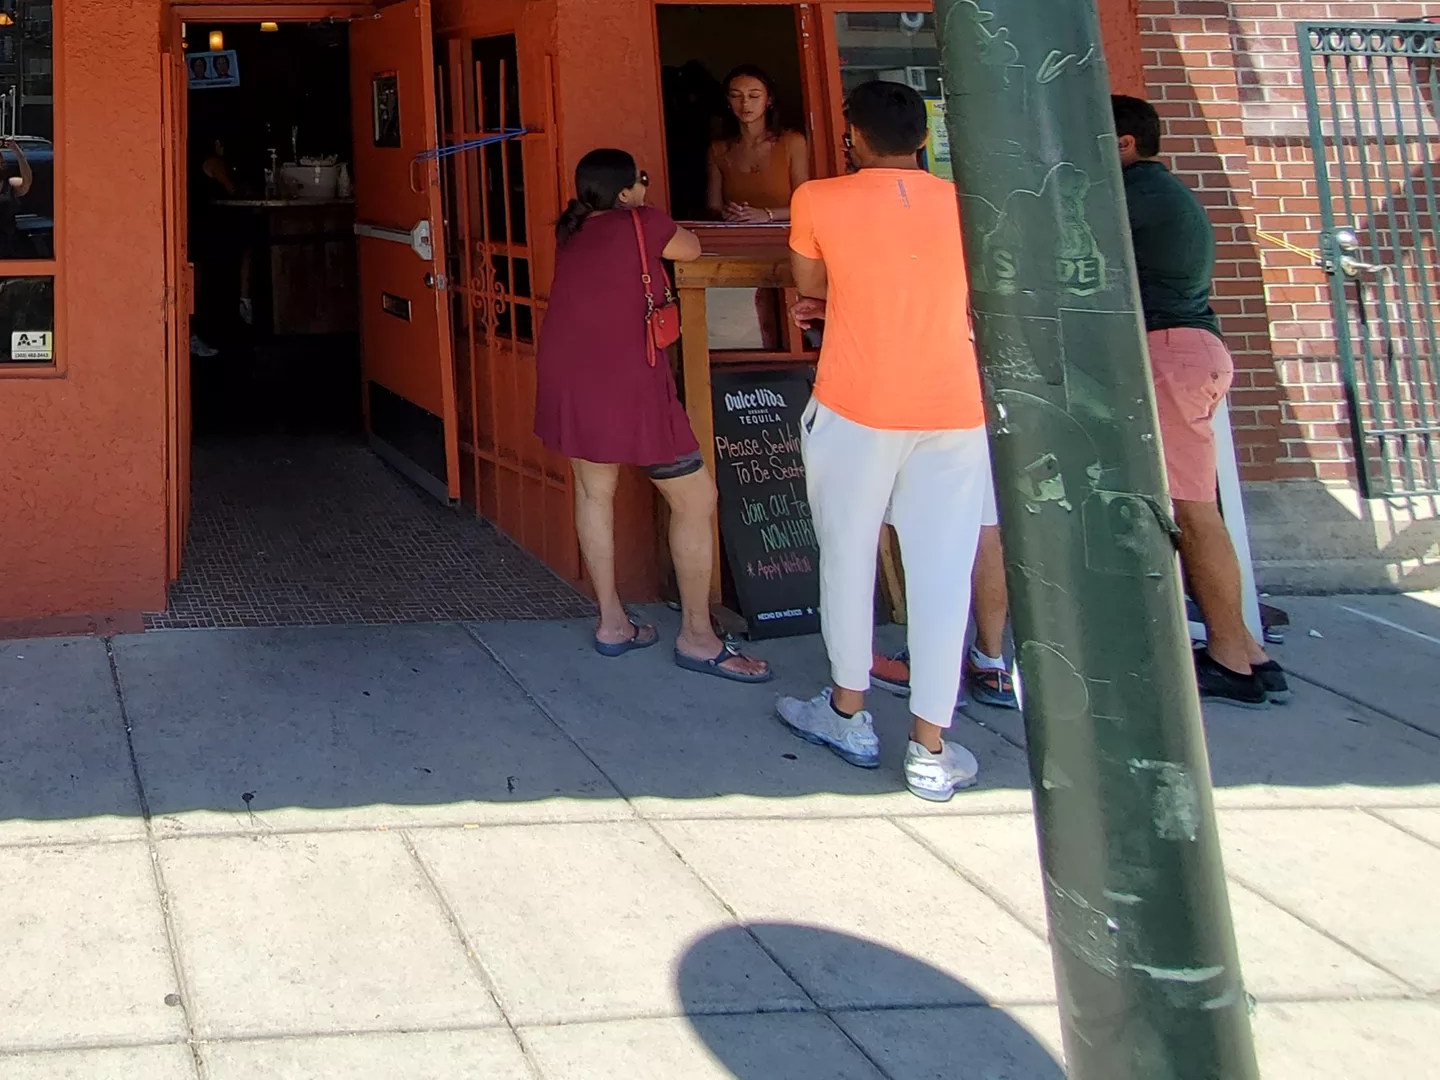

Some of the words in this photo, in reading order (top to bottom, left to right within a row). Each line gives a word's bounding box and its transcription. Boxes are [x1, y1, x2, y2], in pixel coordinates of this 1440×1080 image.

[17, 333, 47, 346] A-1
[739, 413, 782, 424] TEQUILA
[715, 436, 763, 460] Please
[731, 461, 750, 485] To
[750, 459, 770, 483] Be
[769, 456, 806, 480] Seate
[741, 496, 769, 526] Join
[760, 520, 791, 553] NOW
[758, 556, 782, 580] Apply
